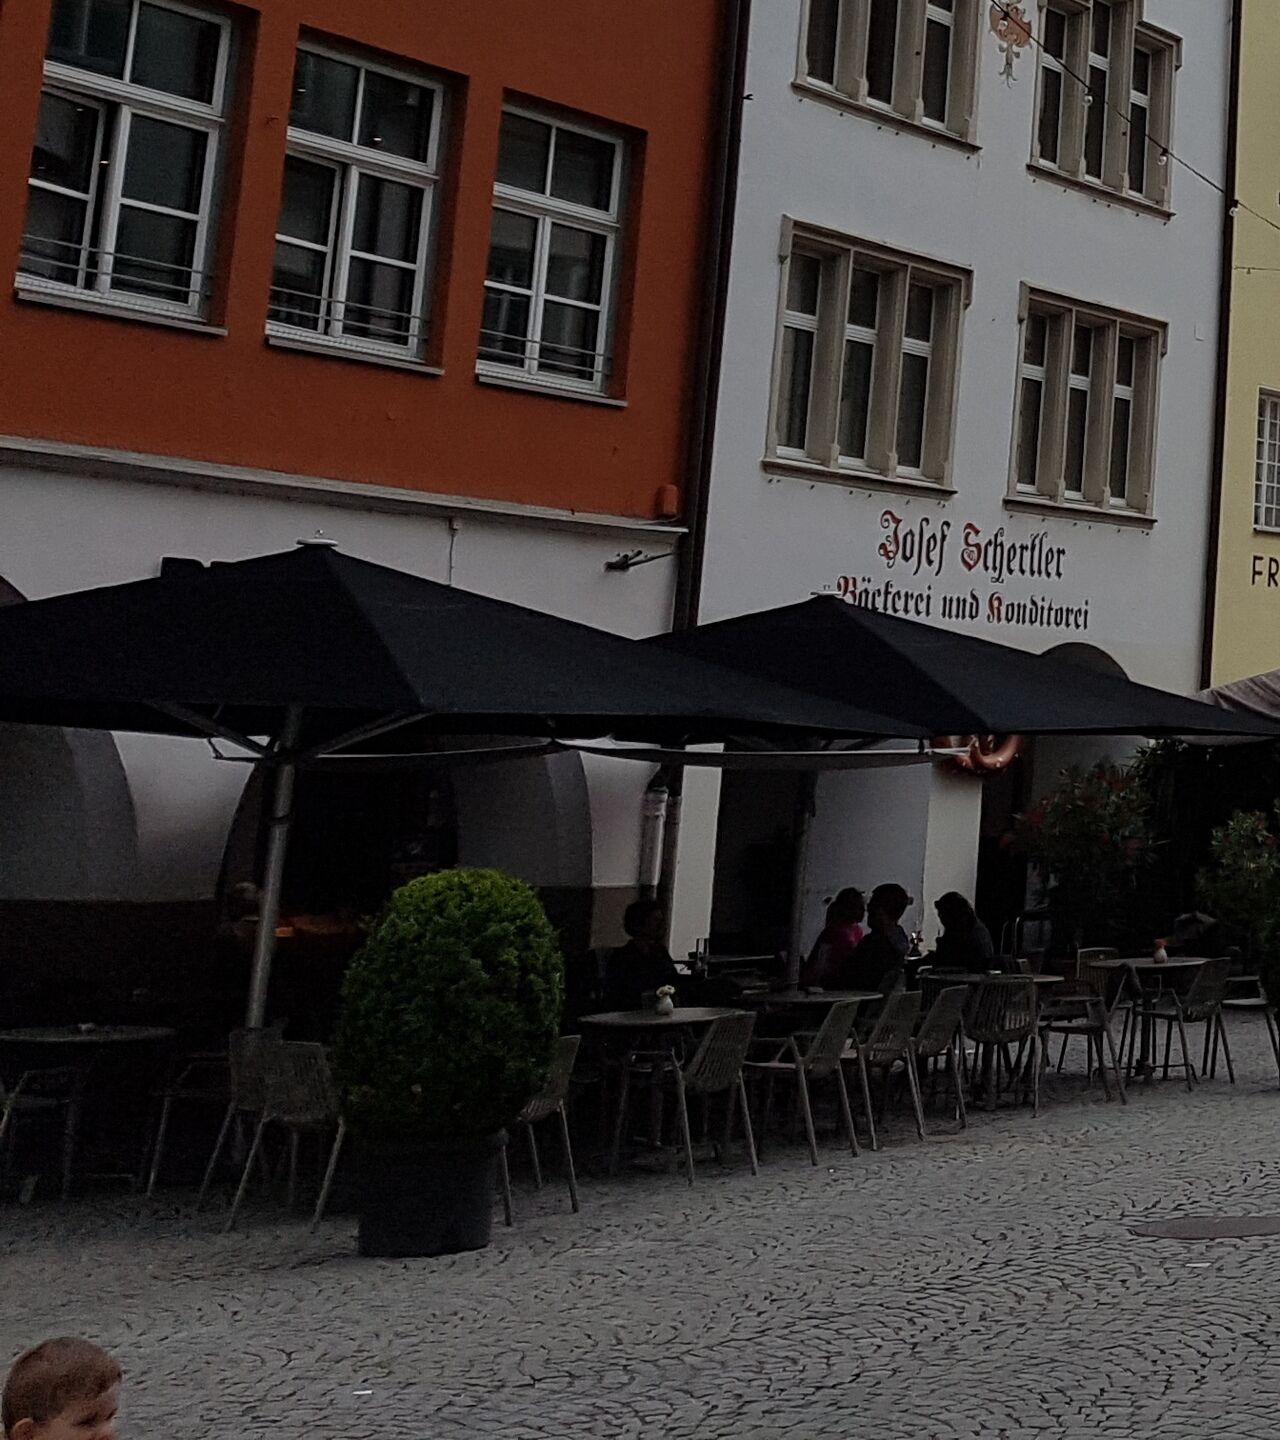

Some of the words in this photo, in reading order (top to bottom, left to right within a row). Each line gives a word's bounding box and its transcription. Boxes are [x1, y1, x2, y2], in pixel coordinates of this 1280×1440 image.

[878, 509, 951, 576] Josef
[961, 522, 1066, 584] Schertler
[837, 575, 932, 617] Bäckerei
[941, 589, 980, 620] und
[987, 591, 1089, 631] Konditorei
